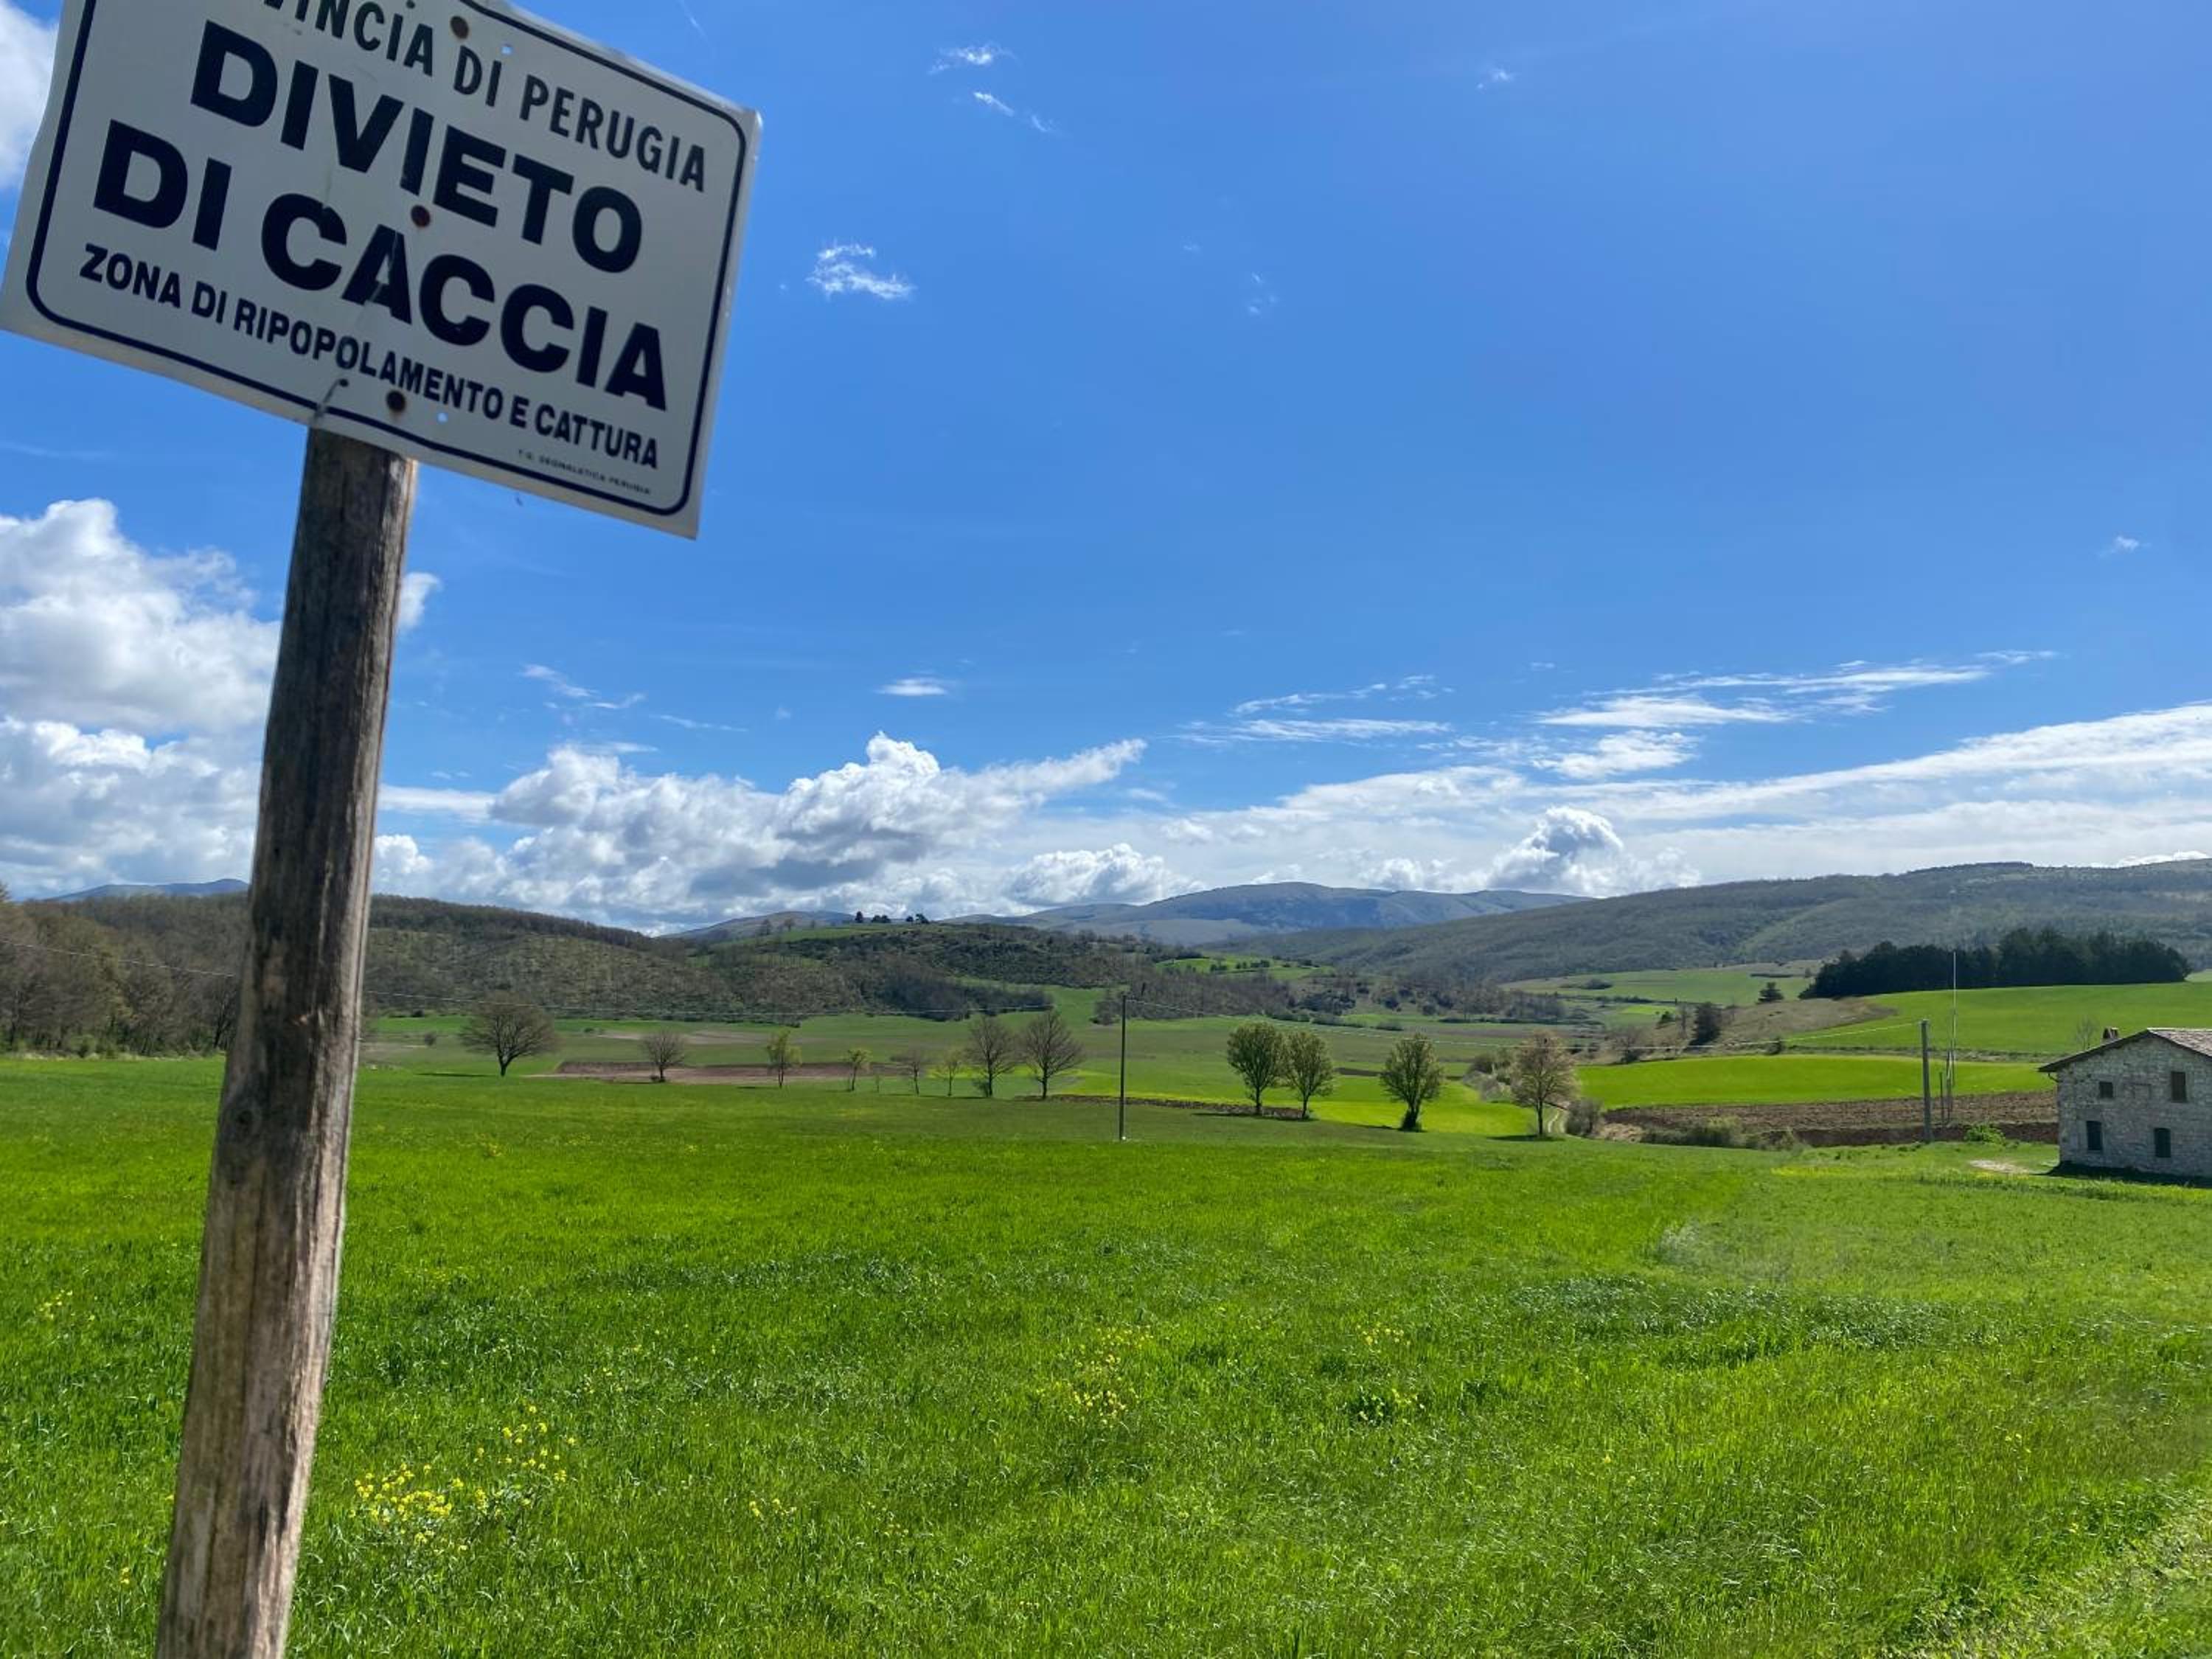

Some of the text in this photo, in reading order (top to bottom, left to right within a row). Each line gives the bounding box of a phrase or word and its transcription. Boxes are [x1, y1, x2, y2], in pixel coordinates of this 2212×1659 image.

[189, 19, 643, 274] DIVIETO
[263, 0, 708, 194] NCIA DI PERUGIA
[79, 243, 658, 470] ZONA DI RIPOPOLAMENTO E CATTURA
[93, 118, 667, 412] DI CACCIA
